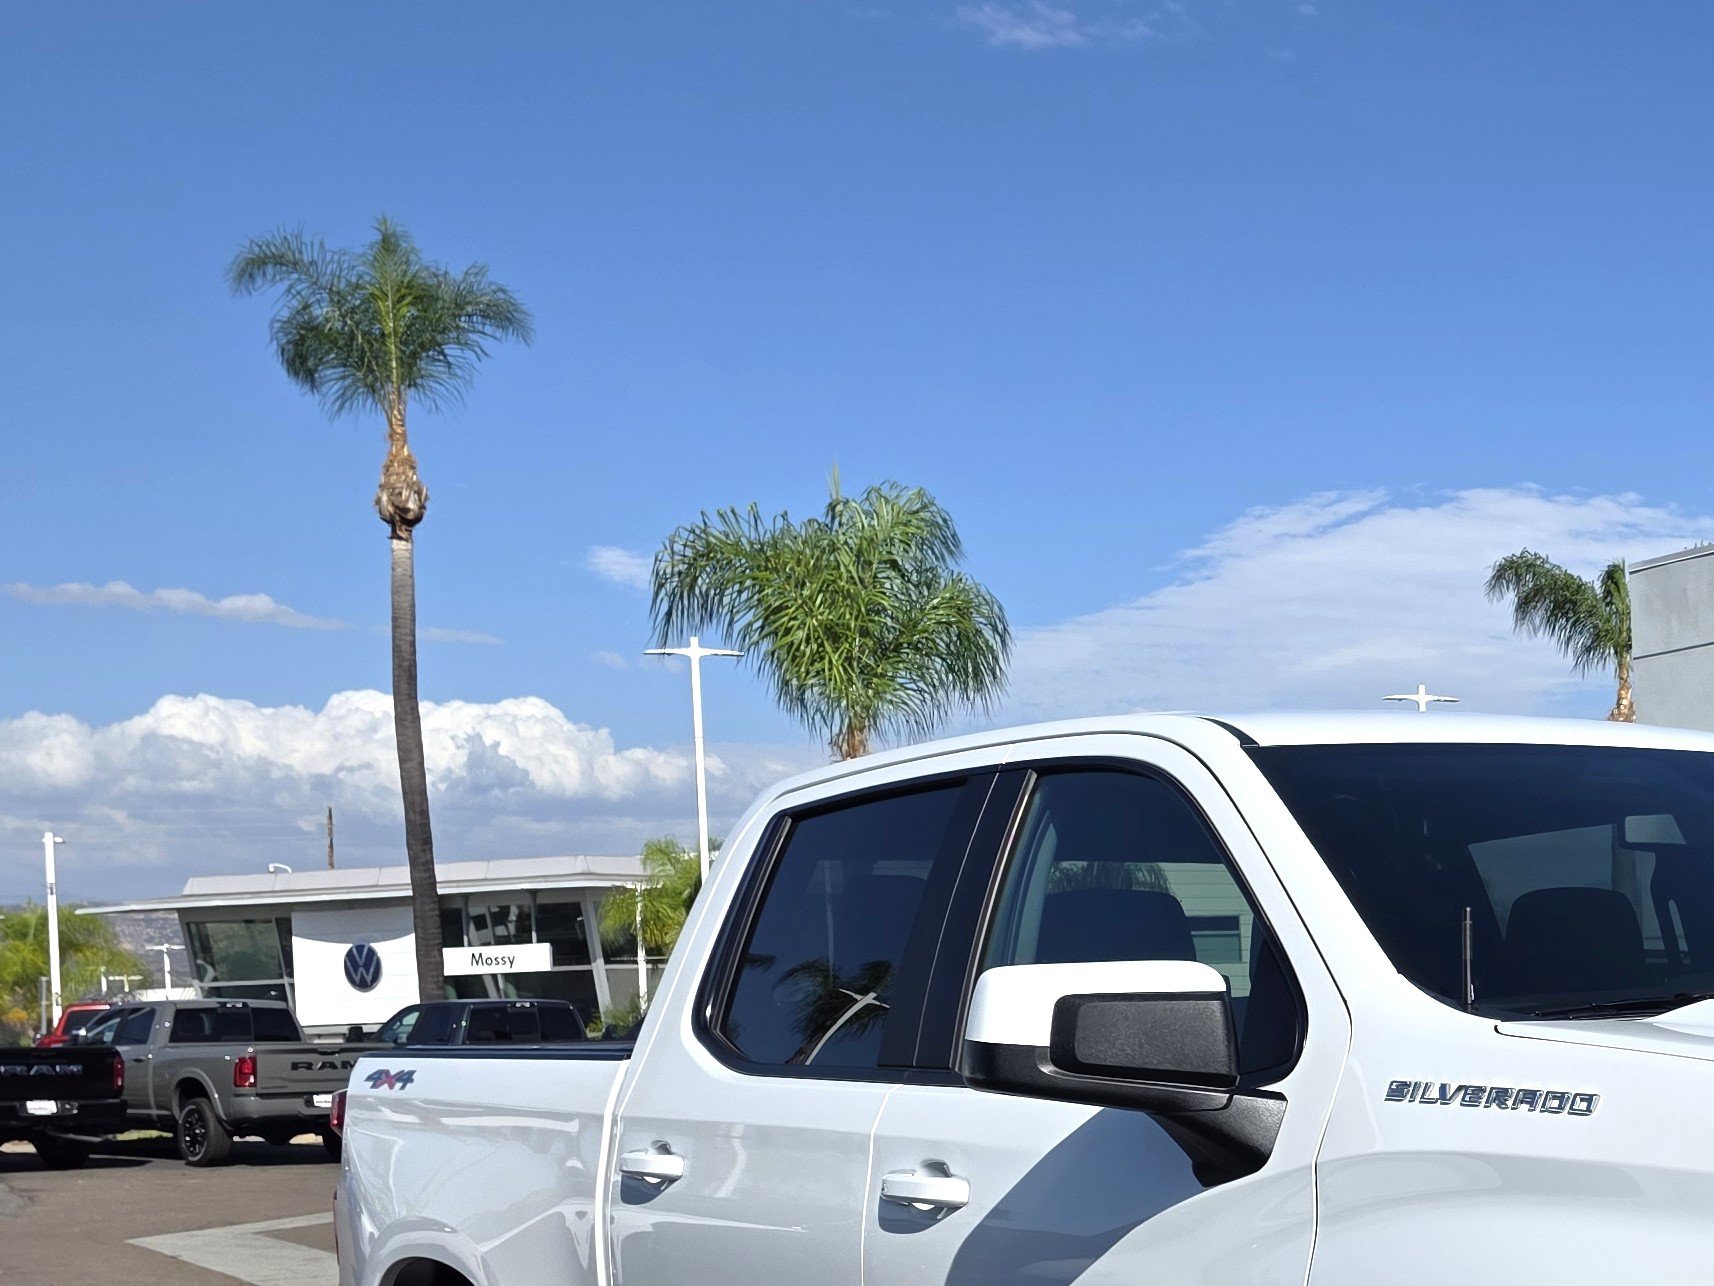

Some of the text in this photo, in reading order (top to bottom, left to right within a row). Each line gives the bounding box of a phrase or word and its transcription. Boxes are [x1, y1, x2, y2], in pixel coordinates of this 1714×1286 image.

[471, 952, 516, 969] Mossy
[0, 1065, 83, 1075] RAM
[1384, 1079, 1602, 1117] SILVERADO
